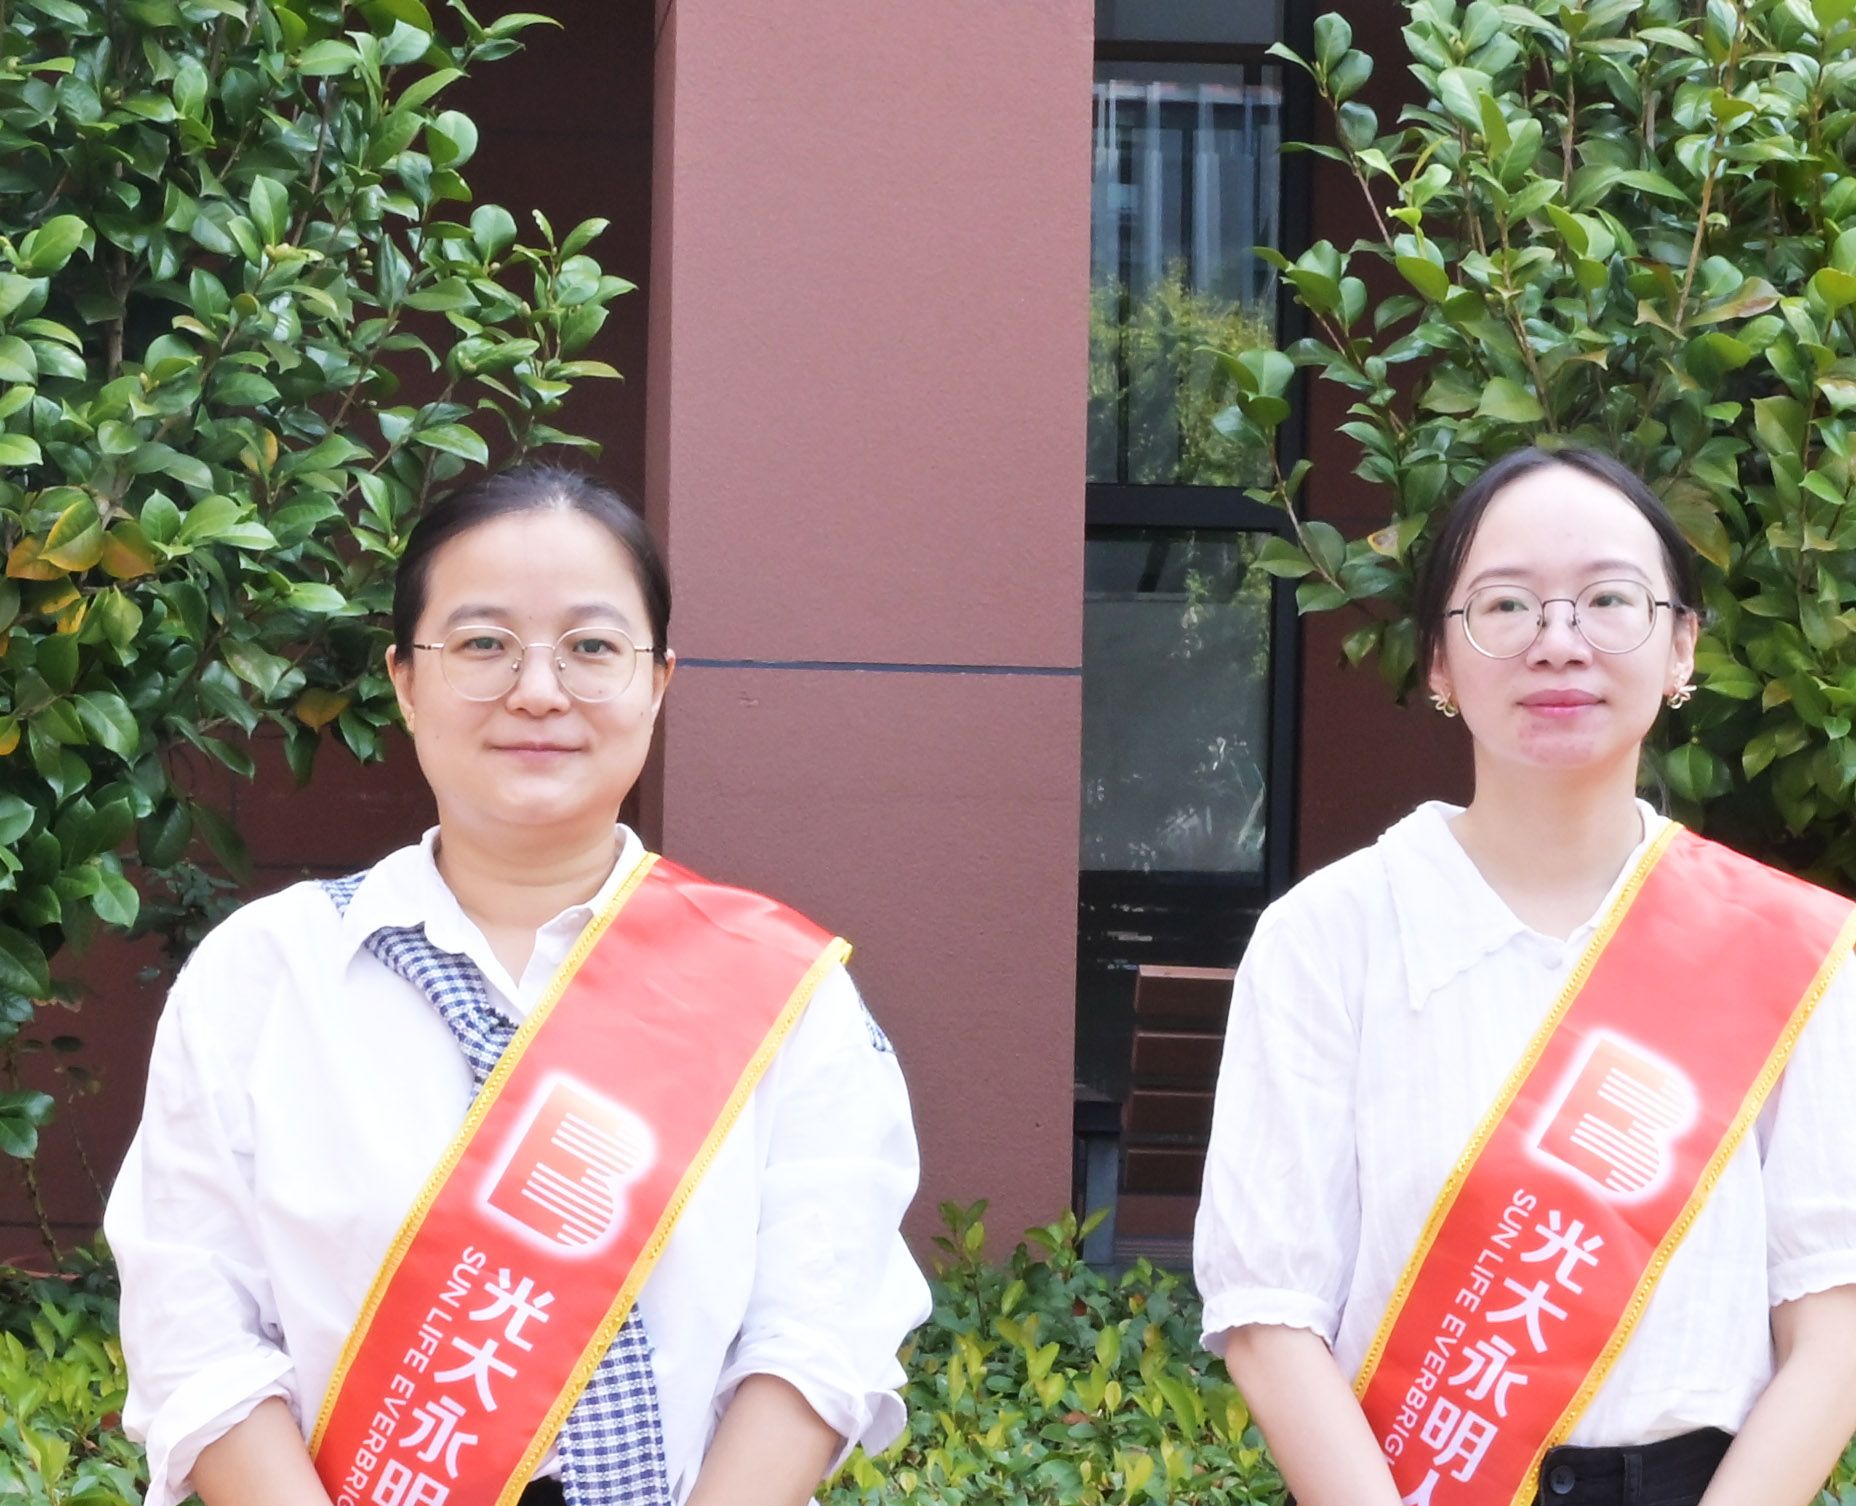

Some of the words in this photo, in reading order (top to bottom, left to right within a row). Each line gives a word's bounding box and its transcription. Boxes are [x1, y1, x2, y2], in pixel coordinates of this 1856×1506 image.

[1489, 1187, 1538, 1250] SUN
[438, 1244, 487, 1308] SUN
[1454, 1247, 1505, 1314] LIFE
[402, 1306, 454, 1375] LIFE
